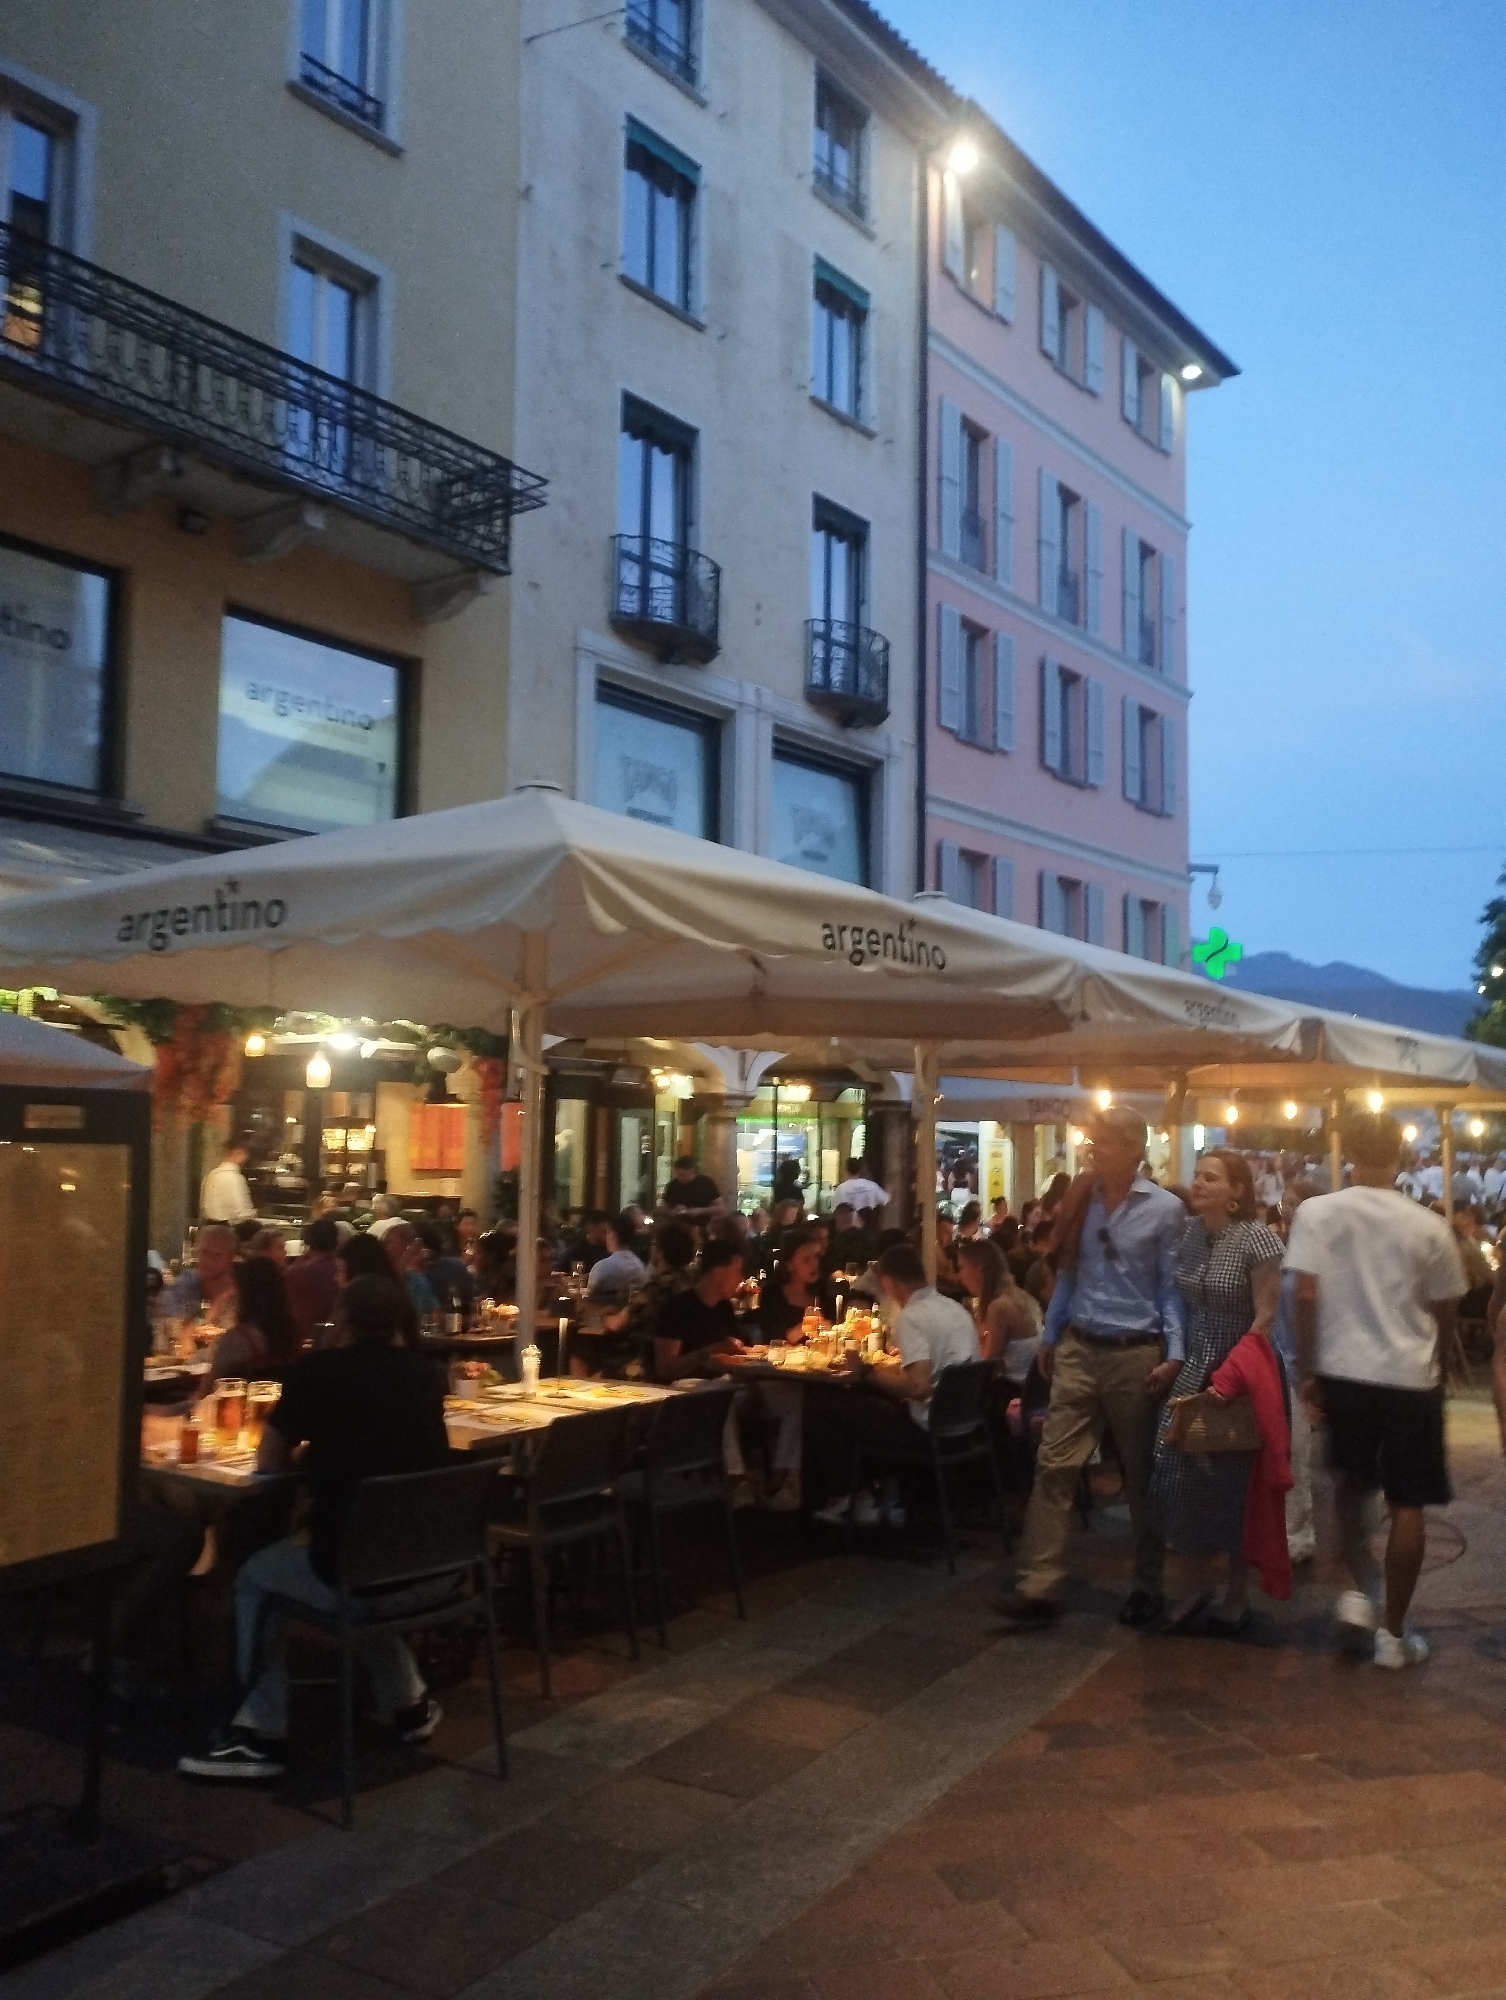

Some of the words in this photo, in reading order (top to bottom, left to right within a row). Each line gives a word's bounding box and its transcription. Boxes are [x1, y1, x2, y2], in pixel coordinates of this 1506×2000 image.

[246, 682, 376, 731] argentino
[117, 877, 287, 951] argentino
[821, 918, 947, 970] argentino
